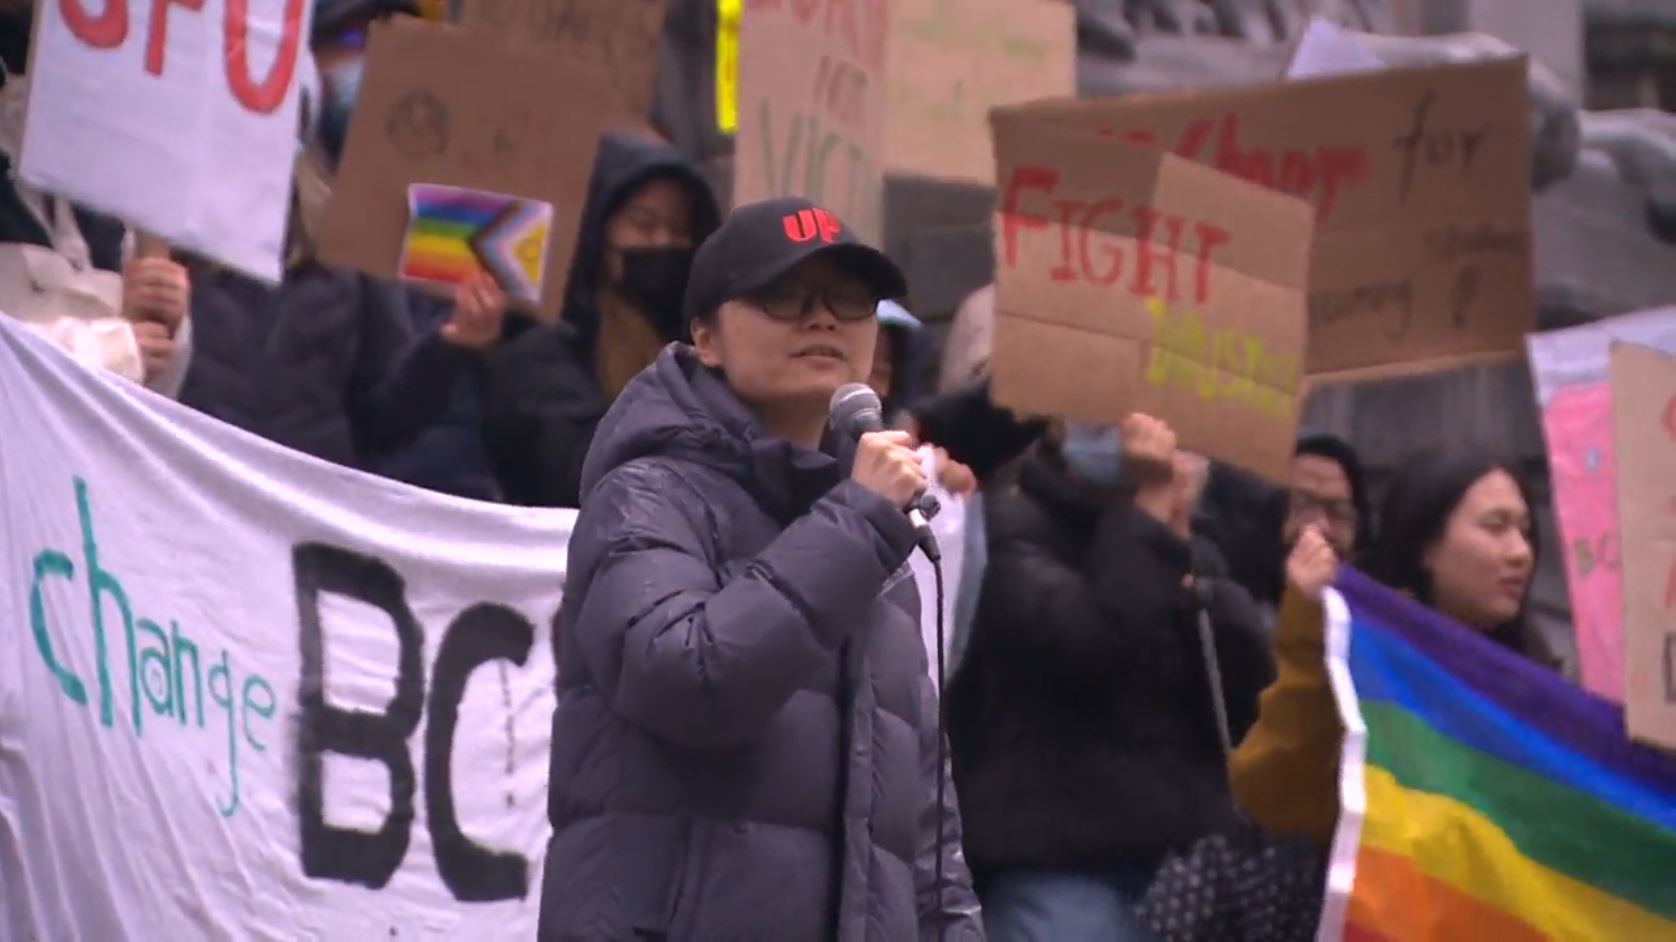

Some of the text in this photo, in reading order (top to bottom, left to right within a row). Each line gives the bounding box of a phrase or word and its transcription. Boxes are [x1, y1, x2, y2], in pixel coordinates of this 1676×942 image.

[1002, 167, 1231, 304] FIGHT
[29, 475, 536, 903] change BC
